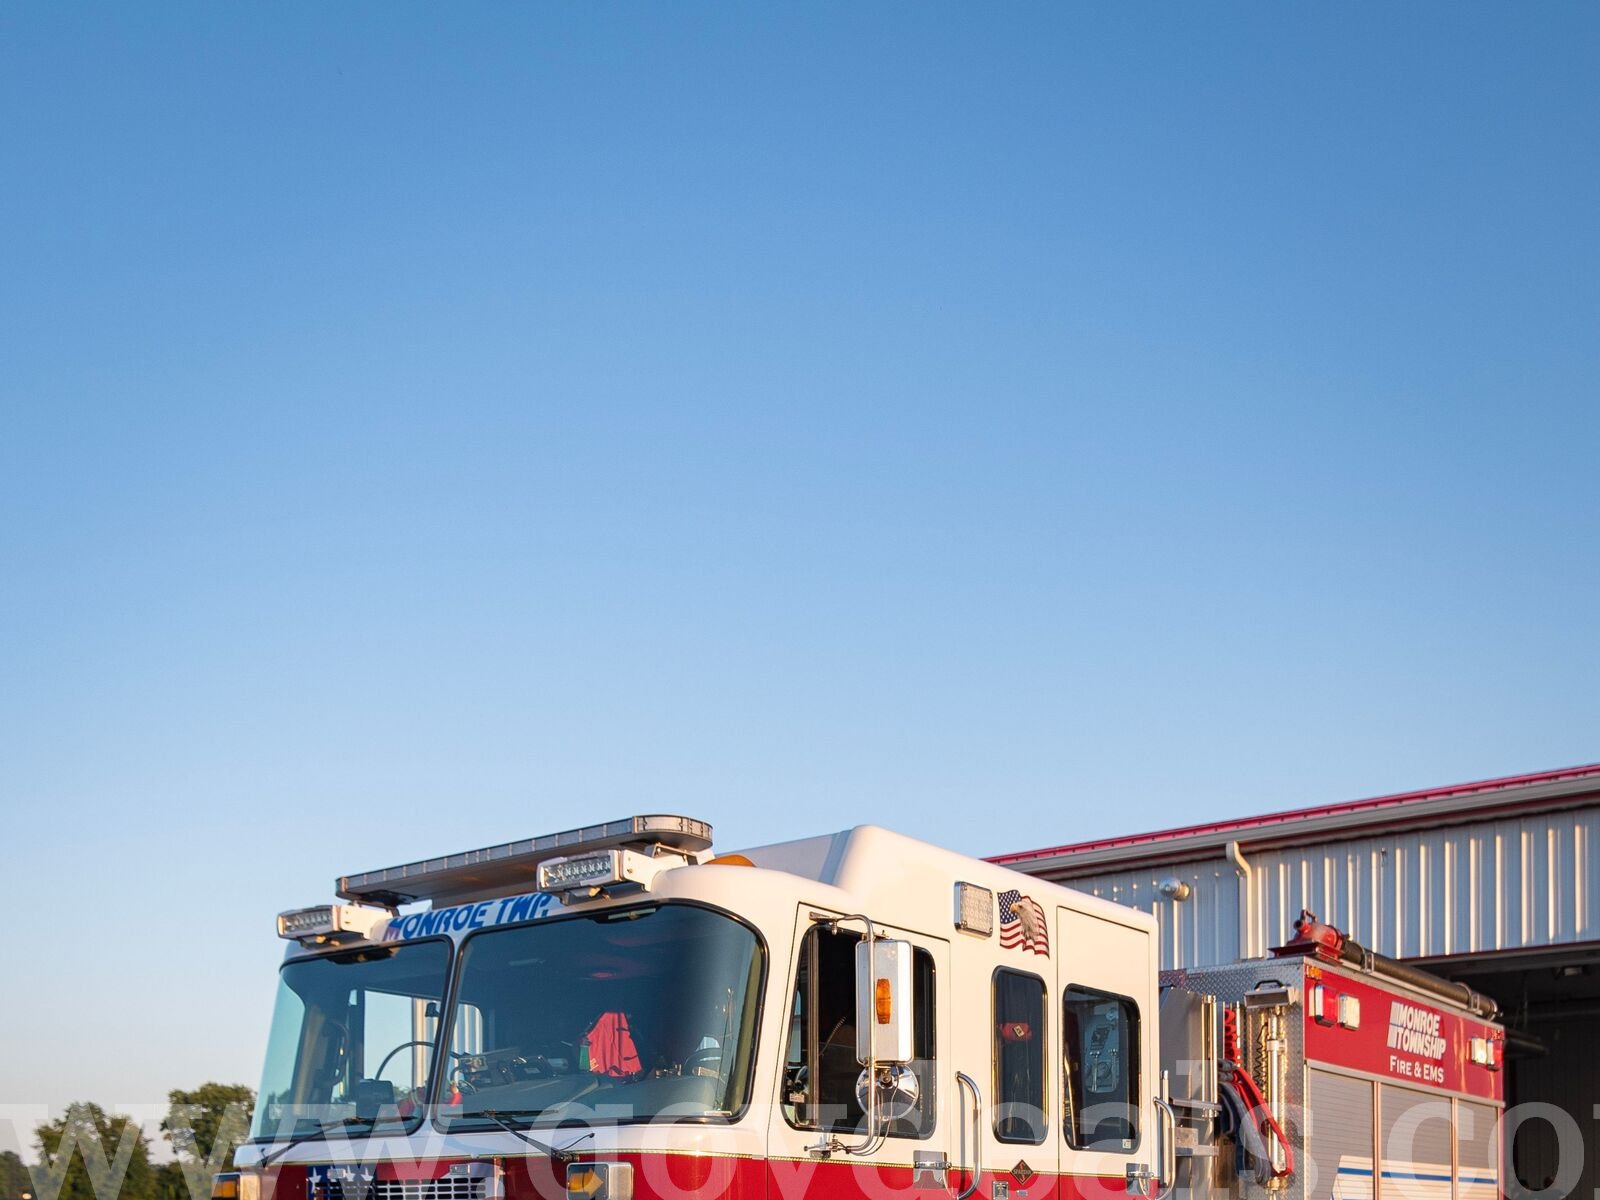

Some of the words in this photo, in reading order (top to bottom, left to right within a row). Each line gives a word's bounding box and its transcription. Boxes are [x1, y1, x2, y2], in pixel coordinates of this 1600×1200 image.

[382, 901, 493, 942] MONROE
[1399, 1003, 1441, 1037] MONROE
[1397, 1027, 1447, 1060] TOWNSHIP
[1389, 1055, 1413, 1077] FIRE
[1414, 1061, 1422, 1078] &
[1423, 1063, 1445, 1083] EMS
